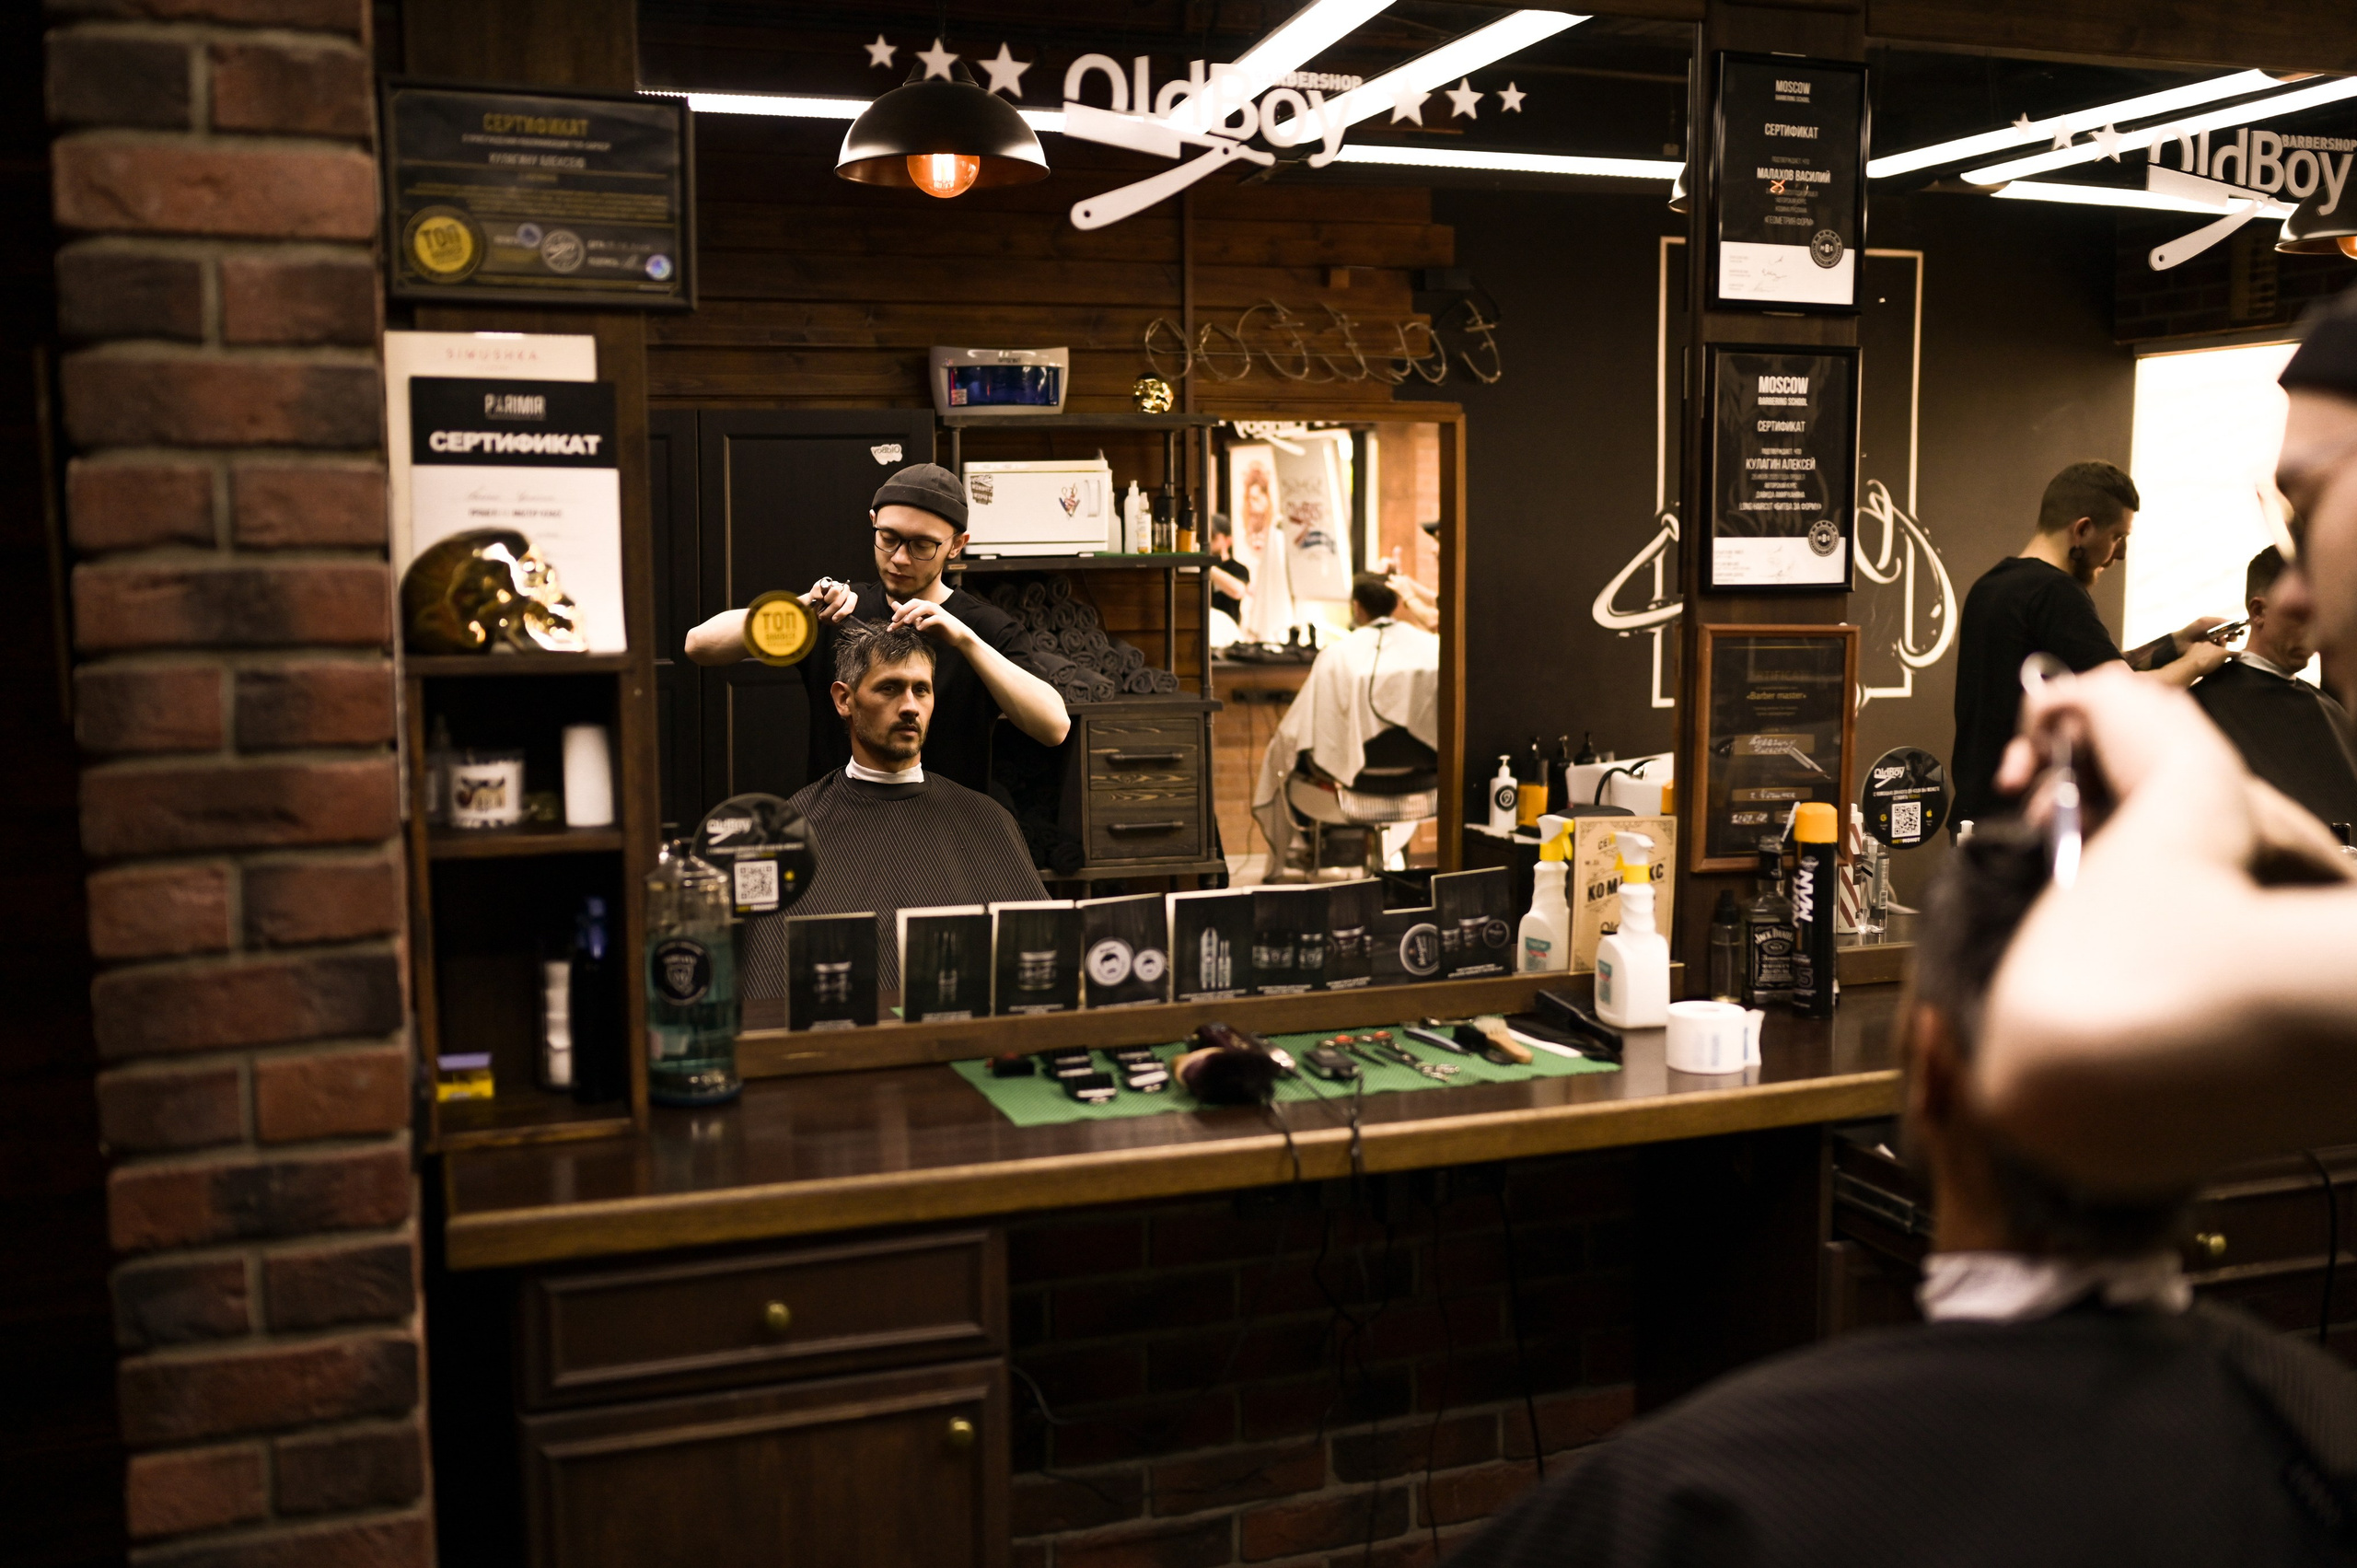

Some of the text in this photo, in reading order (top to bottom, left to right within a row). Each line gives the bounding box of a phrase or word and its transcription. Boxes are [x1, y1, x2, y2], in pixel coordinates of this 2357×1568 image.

[1775, 79, 1811, 94] MOSCOW
[1064, 53, 1353, 167] OldBoy
[1764, 122, 1819, 139] СЕРТИФИКАТ
[2281, 134, 2357, 151] BARBERSHOP
[1757, 167, 1831, 184] МАЛАХОВ ВАСИЛИЙ
[2148, 126, 2353, 215] OldBoy
[1759, 376, 1809, 394] MOSCOW
[1757, 420, 1806, 432] СЕРТИФИКАТ
[429, 430, 602, 456] СЕРТИФИКАТ
[1746, 457, 1816, 470] КУЛАГИН АЛЕКСЕЙ
[762, 610, 797, 632] ТОП
[1874, 767, 1905, 779] OldBoy
[1587, 863, 1664, 902] КОМКС
